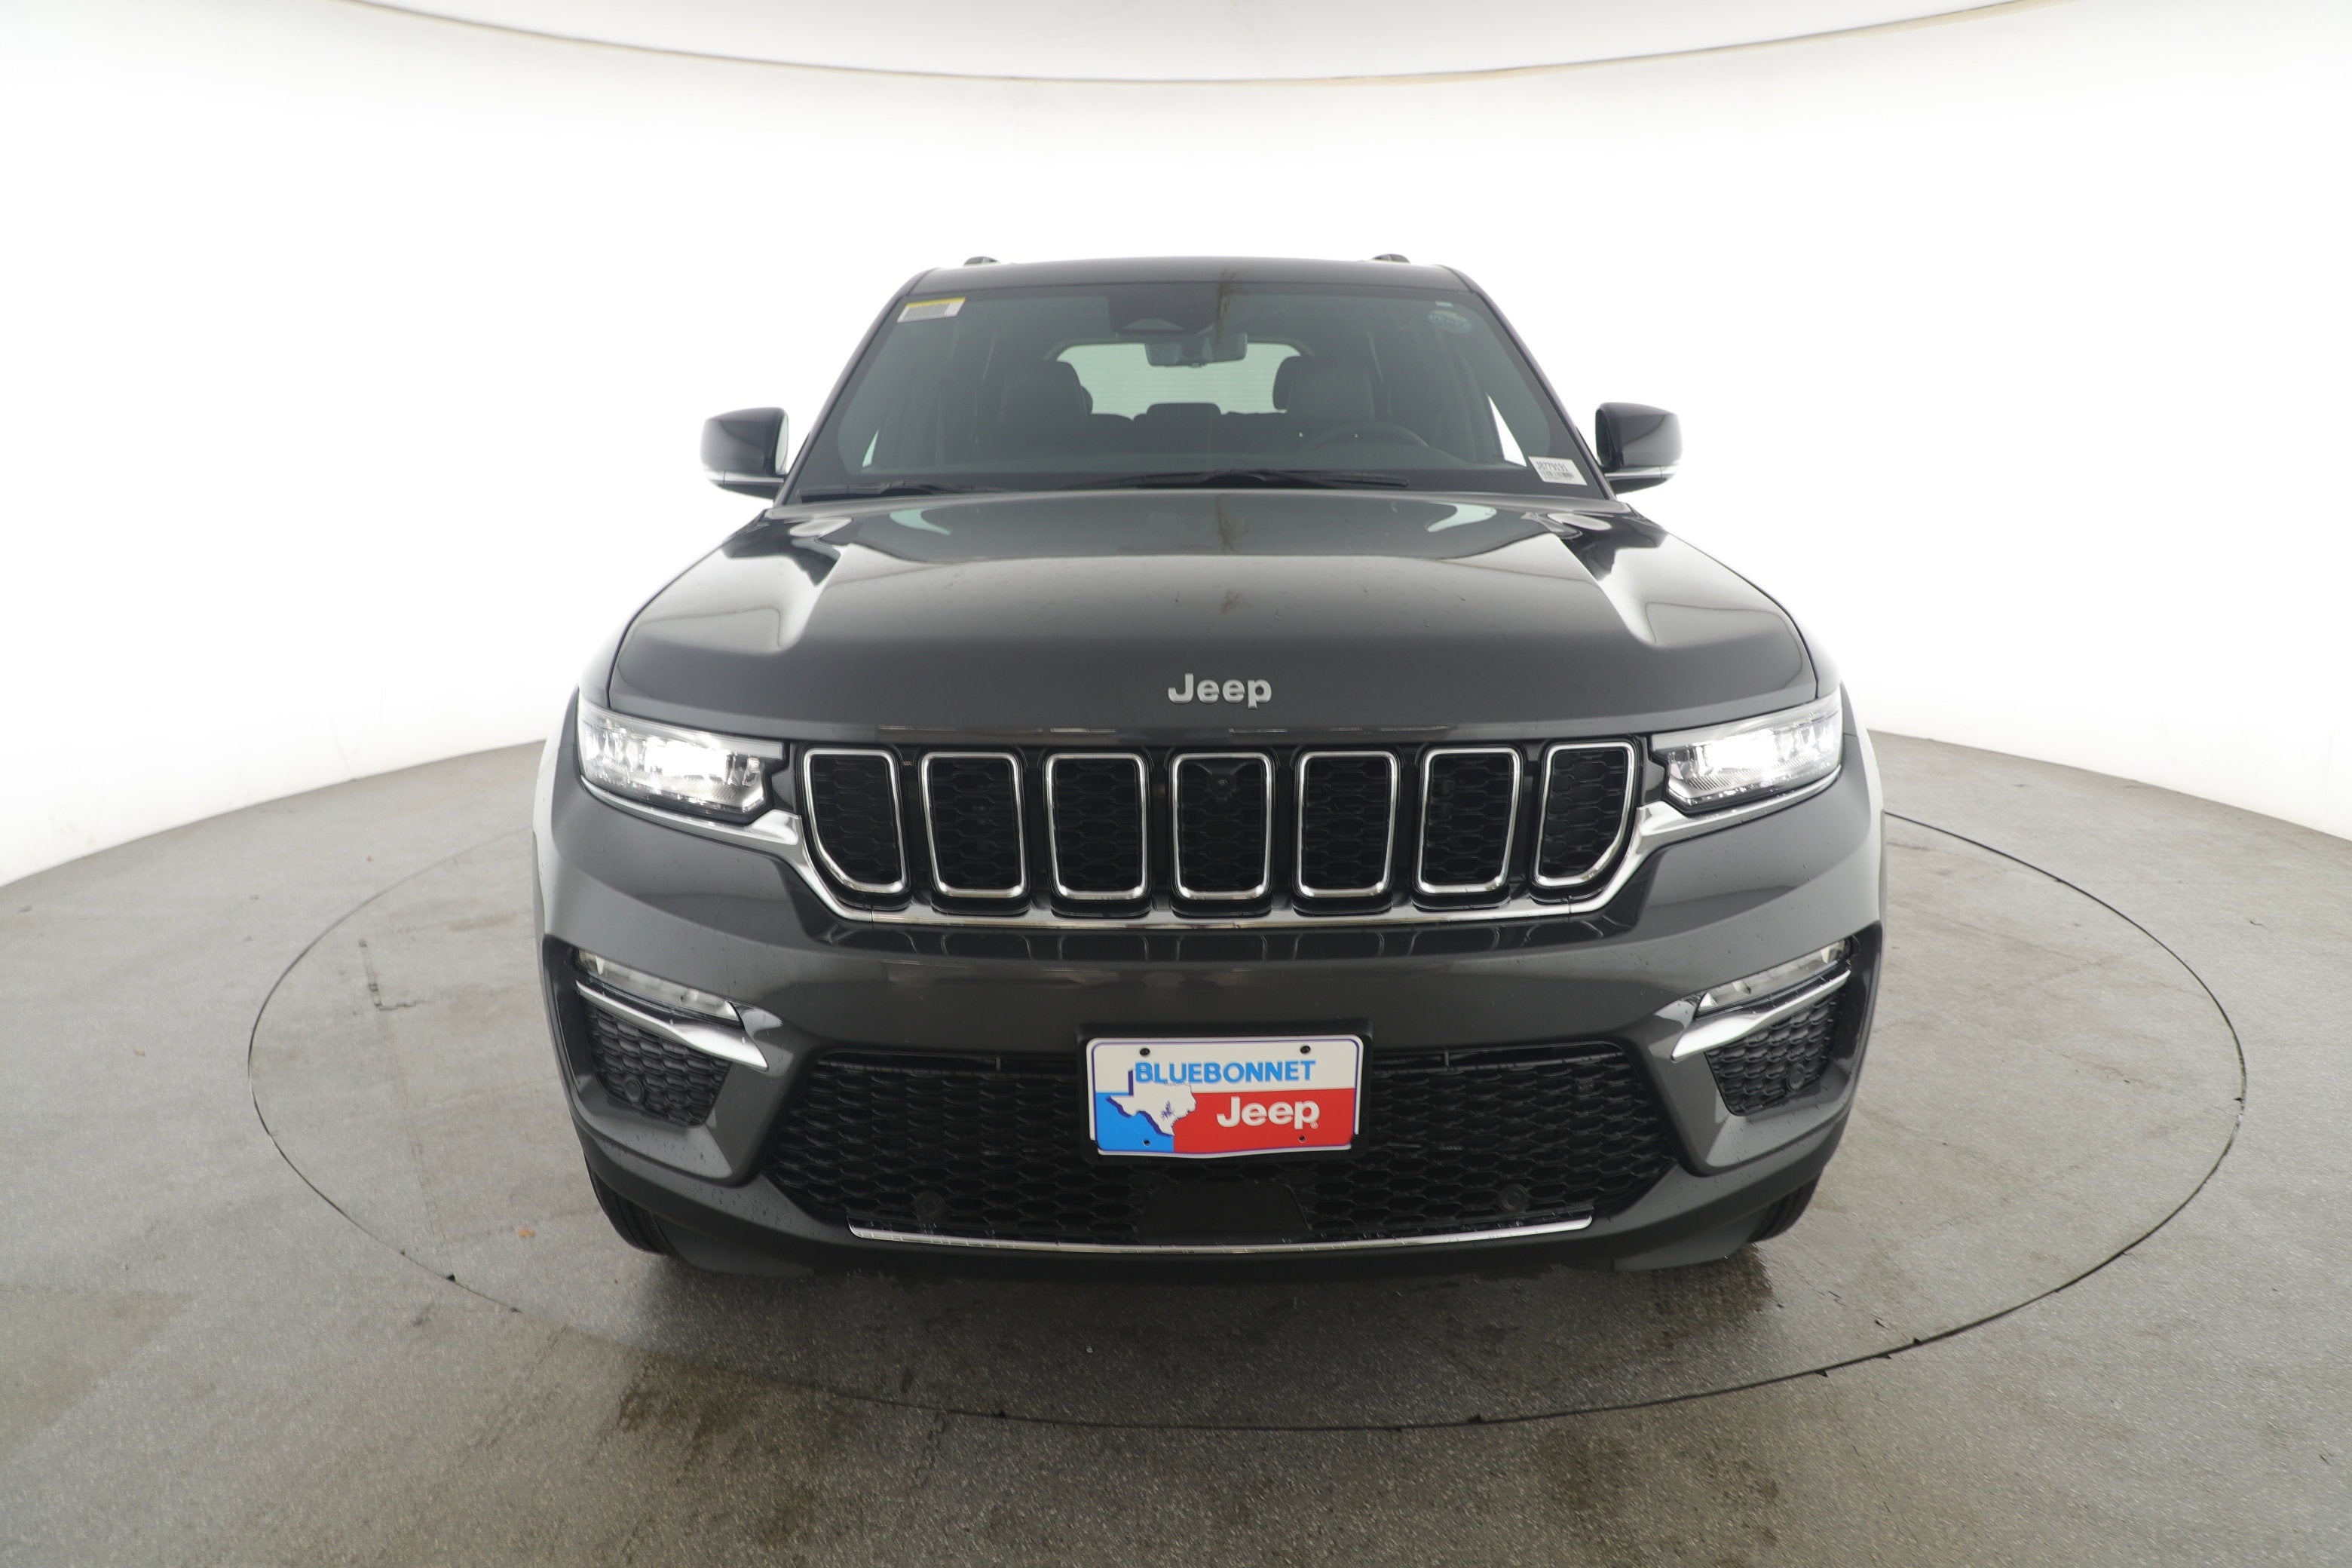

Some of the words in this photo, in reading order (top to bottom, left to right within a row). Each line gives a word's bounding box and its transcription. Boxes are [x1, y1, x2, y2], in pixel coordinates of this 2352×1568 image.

[1168, 673, 1272, 709] Jeep
[1135, 1060, 1315, 1083] BLUEBONNET
[1216, 1096, 1320, 1129] Jeep
